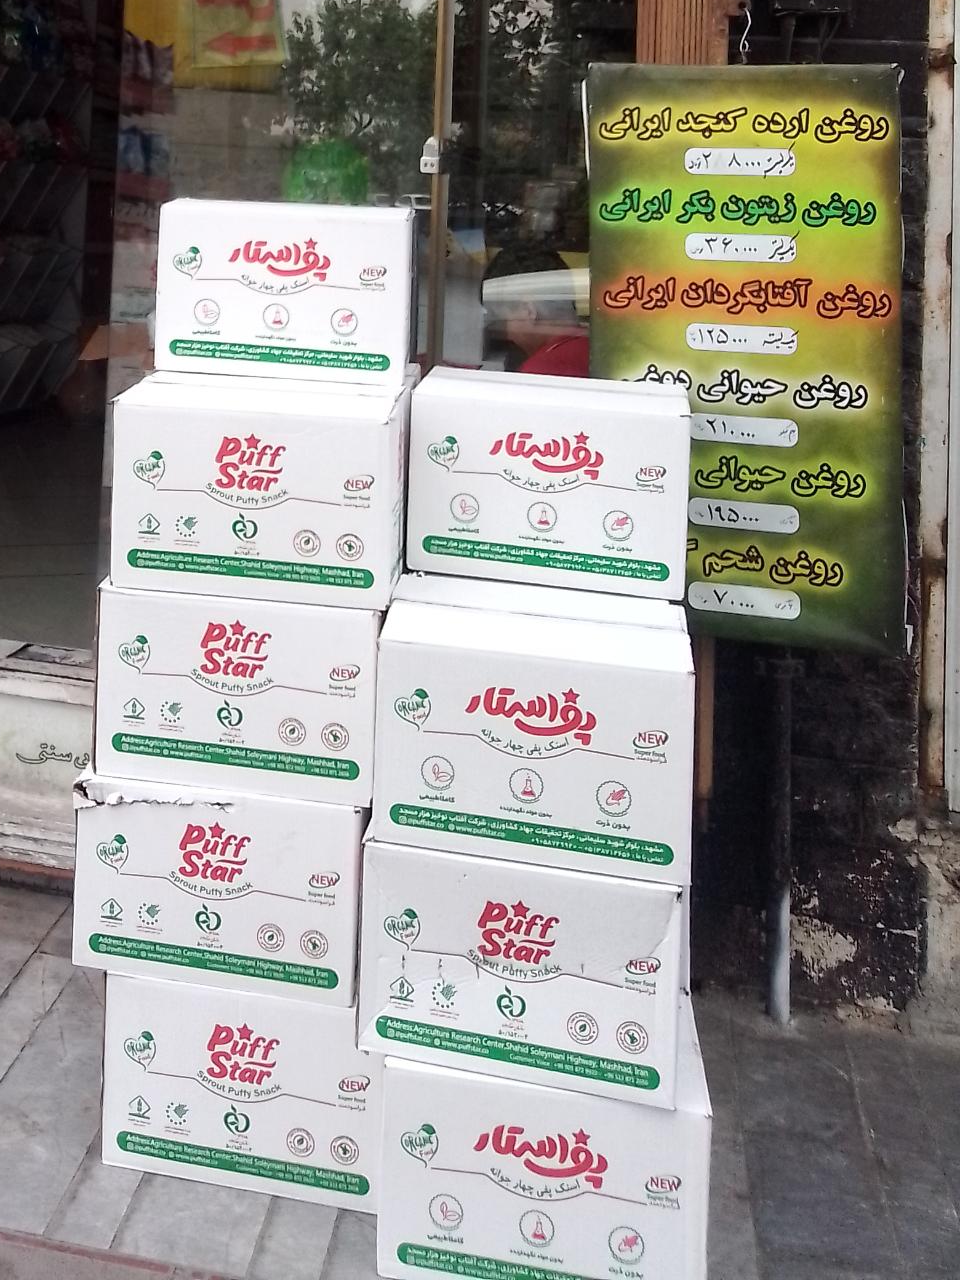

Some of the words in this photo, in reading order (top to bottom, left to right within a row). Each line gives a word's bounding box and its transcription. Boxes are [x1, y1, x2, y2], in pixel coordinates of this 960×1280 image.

[599, 107, 672, 140] ایرانی
[676, 107, 747, 138] کنجد
[752, 108, 809, 138] ارده
[814, 108, 890, 142] روغن
[599, 188, 672, 223] ایرانی
[676, 190, 716, 224] بکر
[721, 193, 797, 226] زیتون
[802, 193, 877, 229] روغن
[603, 275, 676, 309] ایرانی
[681, 277, 813, 313] آفتابگردان
[817, 283, 892, 318] روغن
[697, 369, 787, 405] حیوانی
[793, 374, 868, 408] روغن
[214, 435, 287, 468] Puff
[214, 461, 279, 493] Star
[346, 478, 373, 491] NEW
[639, 466, 666, 480] NEW
[694, 455, 786, 490] حیوانی
[791, 463, 867, 498] روغن
[702, 545, 765, 577] شحم
[769, 550, 844, 586] روغن
[200, 621, 273, 655] Puff
[199, 647, 265, 679] Star
[464, 686, 557, 723] استار
[503, 740, 524, 754] چهار
[637, 731, 666, 746] NEW
[178, 823, 252, 859] Puff
[168, 870, 198, 892] Sprout
[224, 881, 254, 896] Snack
[178, 849, 244, 884] Star
[477, 900, 560, 939] Puff
[477, 928, 552, 964] Star
[530, 964, 563, 978] Snack
[629, 959, 659, 974] NEW
[206, 1023, 281, 1061] Puff
[451, 1032, 481, 1044] Research
[206, 1051, 273, 1086] Star
[339, 1078, 370, 1092] NEW
[253, 1083, 283, 1097] Snack
[473, 1124, 569, 1160] استار
[649, 1176, 681, 1192] NEW
